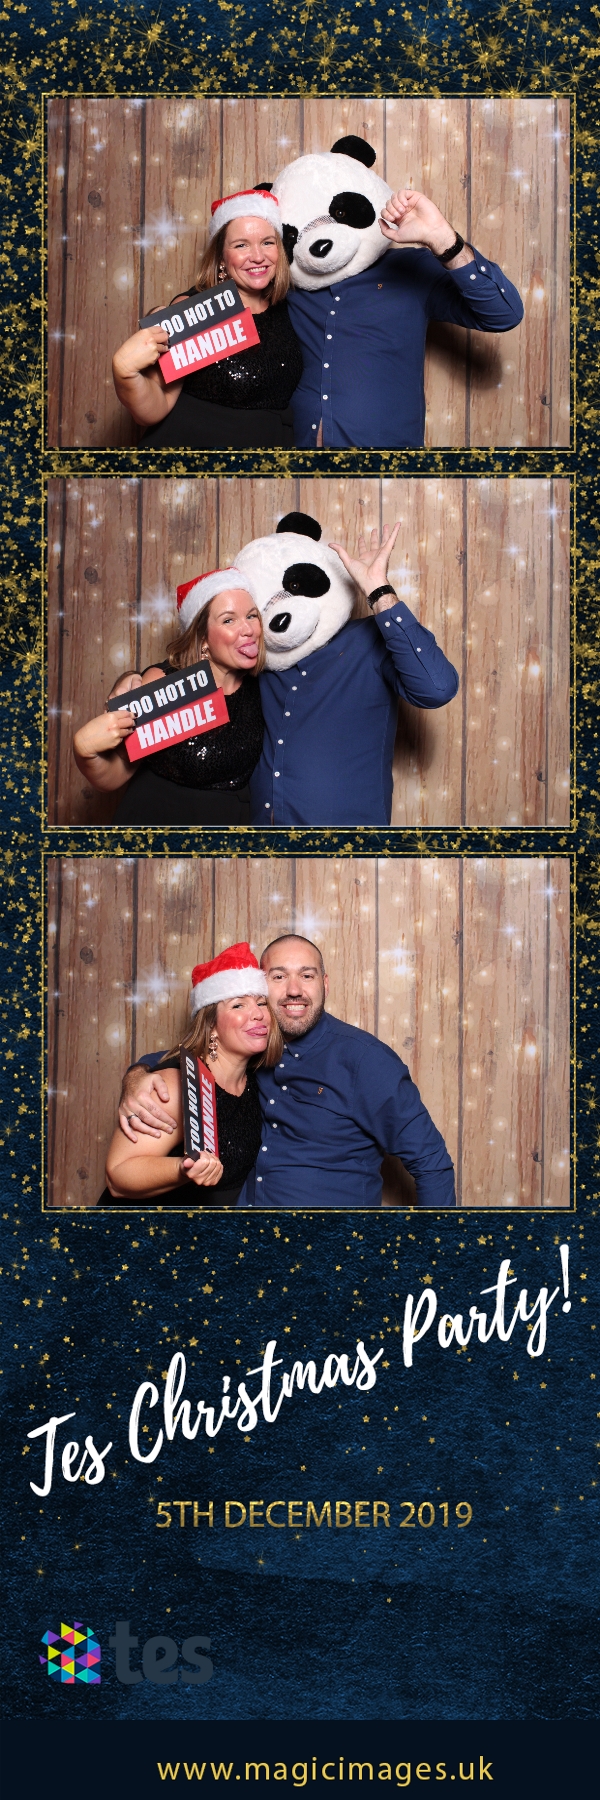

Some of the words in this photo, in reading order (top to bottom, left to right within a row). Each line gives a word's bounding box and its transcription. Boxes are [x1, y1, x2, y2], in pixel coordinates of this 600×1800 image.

[154, 314, 185, 338] OO
[183, 298, 215, 328] HOT
[213, 289, 236, 311] TO
[169, 319, 247, 371] HANDLE
[153, 678, 186, 708] HOT
[186, 669, 209, 692] TO
[135, 699, 217, 749] HANDLE
[185, 1056, 196, 1079] TO
[187, 1077, 199, 1117] HOT
[190, 1116, 201, 1153] TOO
